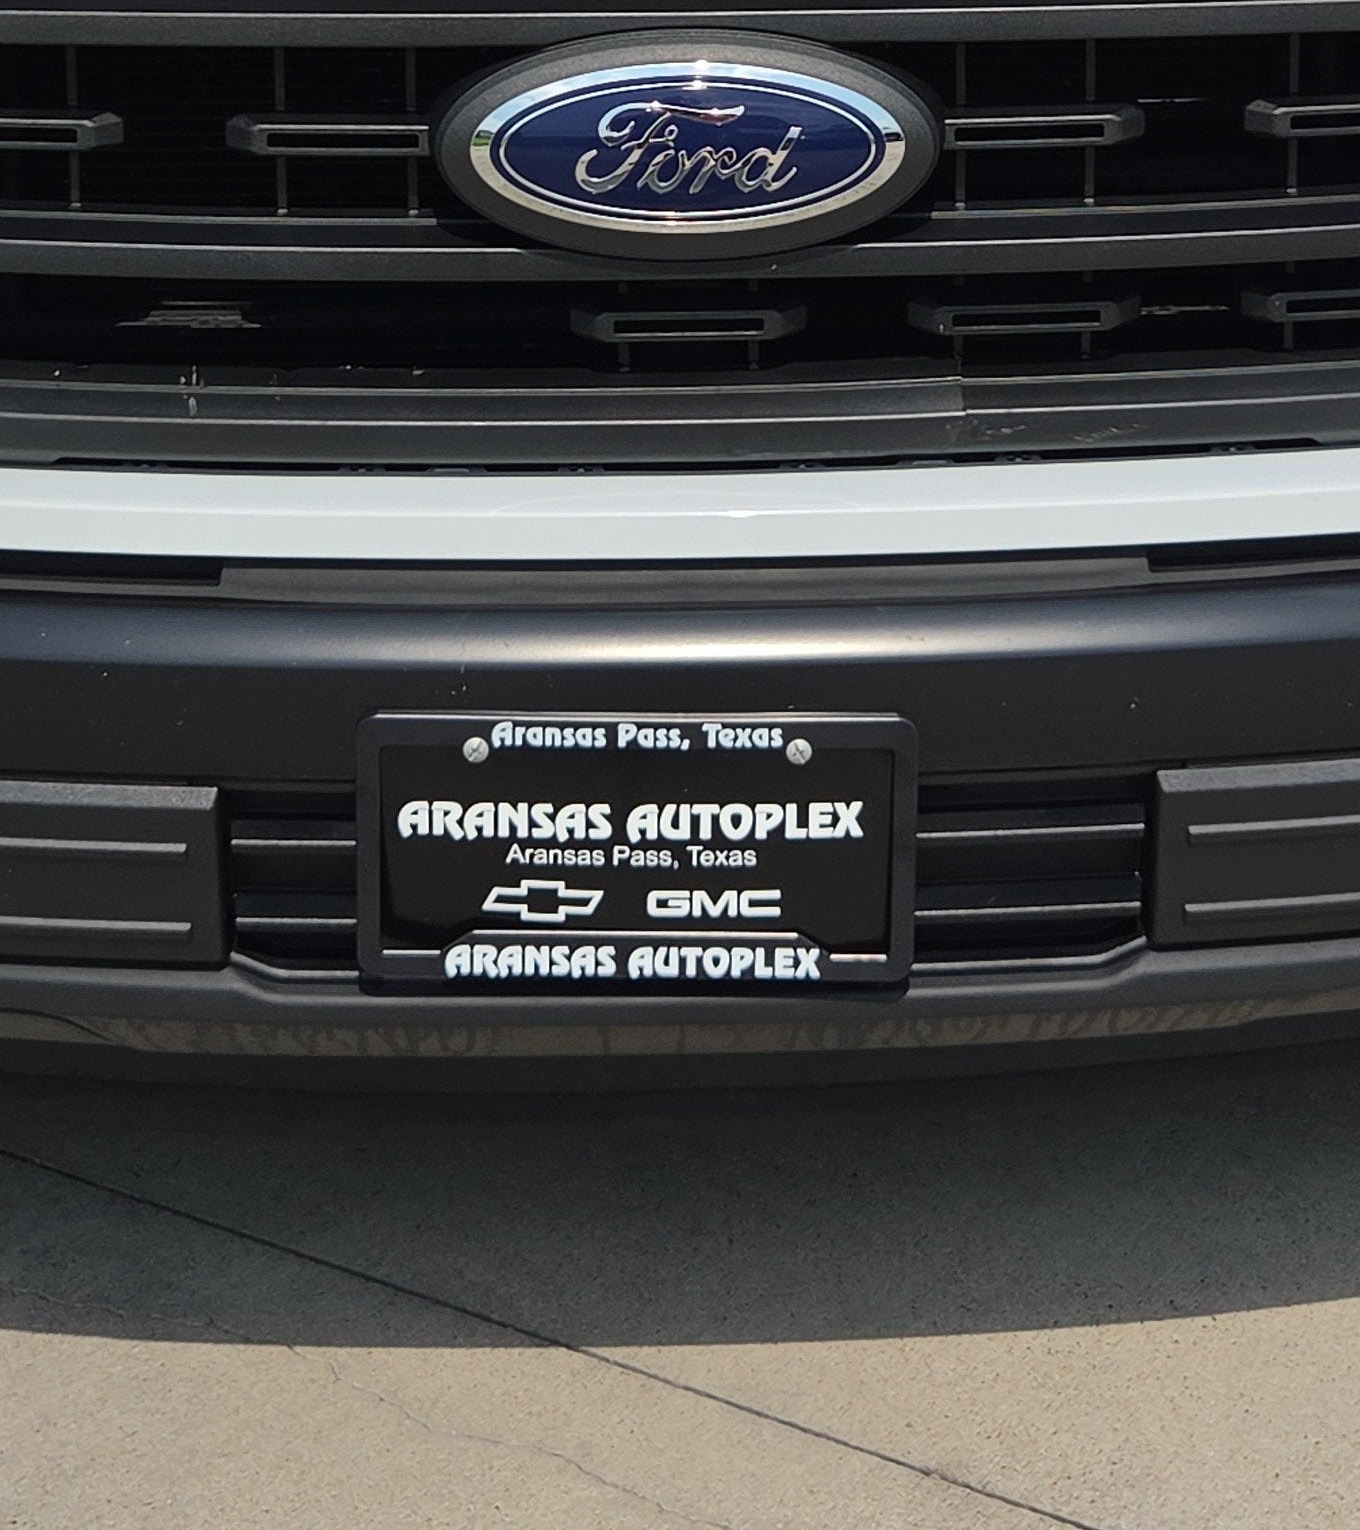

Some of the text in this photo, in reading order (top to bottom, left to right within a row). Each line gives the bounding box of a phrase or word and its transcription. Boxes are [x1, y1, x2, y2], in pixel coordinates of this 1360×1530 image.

[574, 101, 804, 194] Ford
[491, 721, 784, 751] Aransas Pass, Texas
[397, 800, 864, 844] ARANSAS AUTOPLEX
[506, 843, 757, 870] Aransas Pass, Texas
[646, 888, 782, 918] GMC
[444, 944, 821, 980] ARANSAS AUTOPLEX
